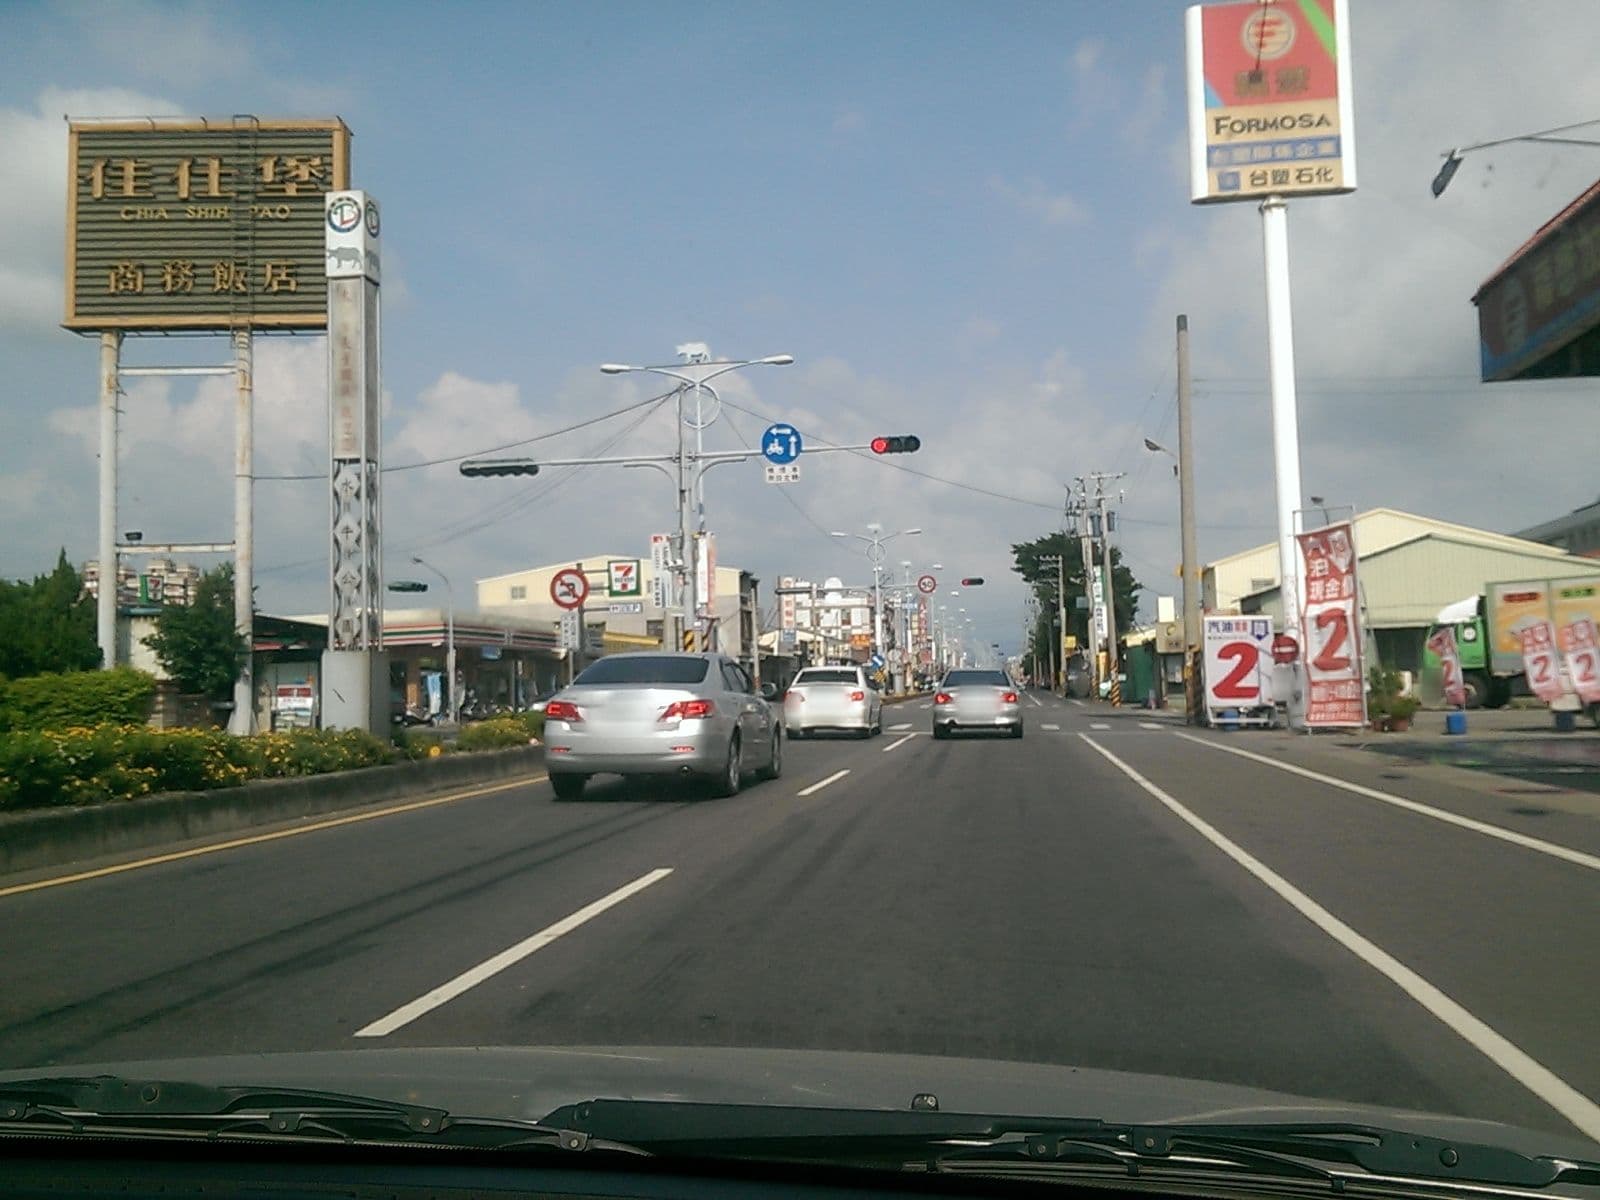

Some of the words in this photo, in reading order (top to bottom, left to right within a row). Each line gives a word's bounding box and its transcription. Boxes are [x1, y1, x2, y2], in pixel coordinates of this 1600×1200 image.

[1214, 113, 1331, 136] FORMOSA
[89, 155, 326, 200] 佳仕堡
[1250, 168, 1334, 187] 台塑石化
[120, 206, 168, 220] CHIA
[185, 205, 231, 219] SHIH
[109, 260, 299, 294] 商務飯店
[1312, 608, 1350, 672] 2
[1212, 642, 1260, 699] 2
[1532, 655, 1550, 682] 2
[1576, 653, 1596, 682] 2
